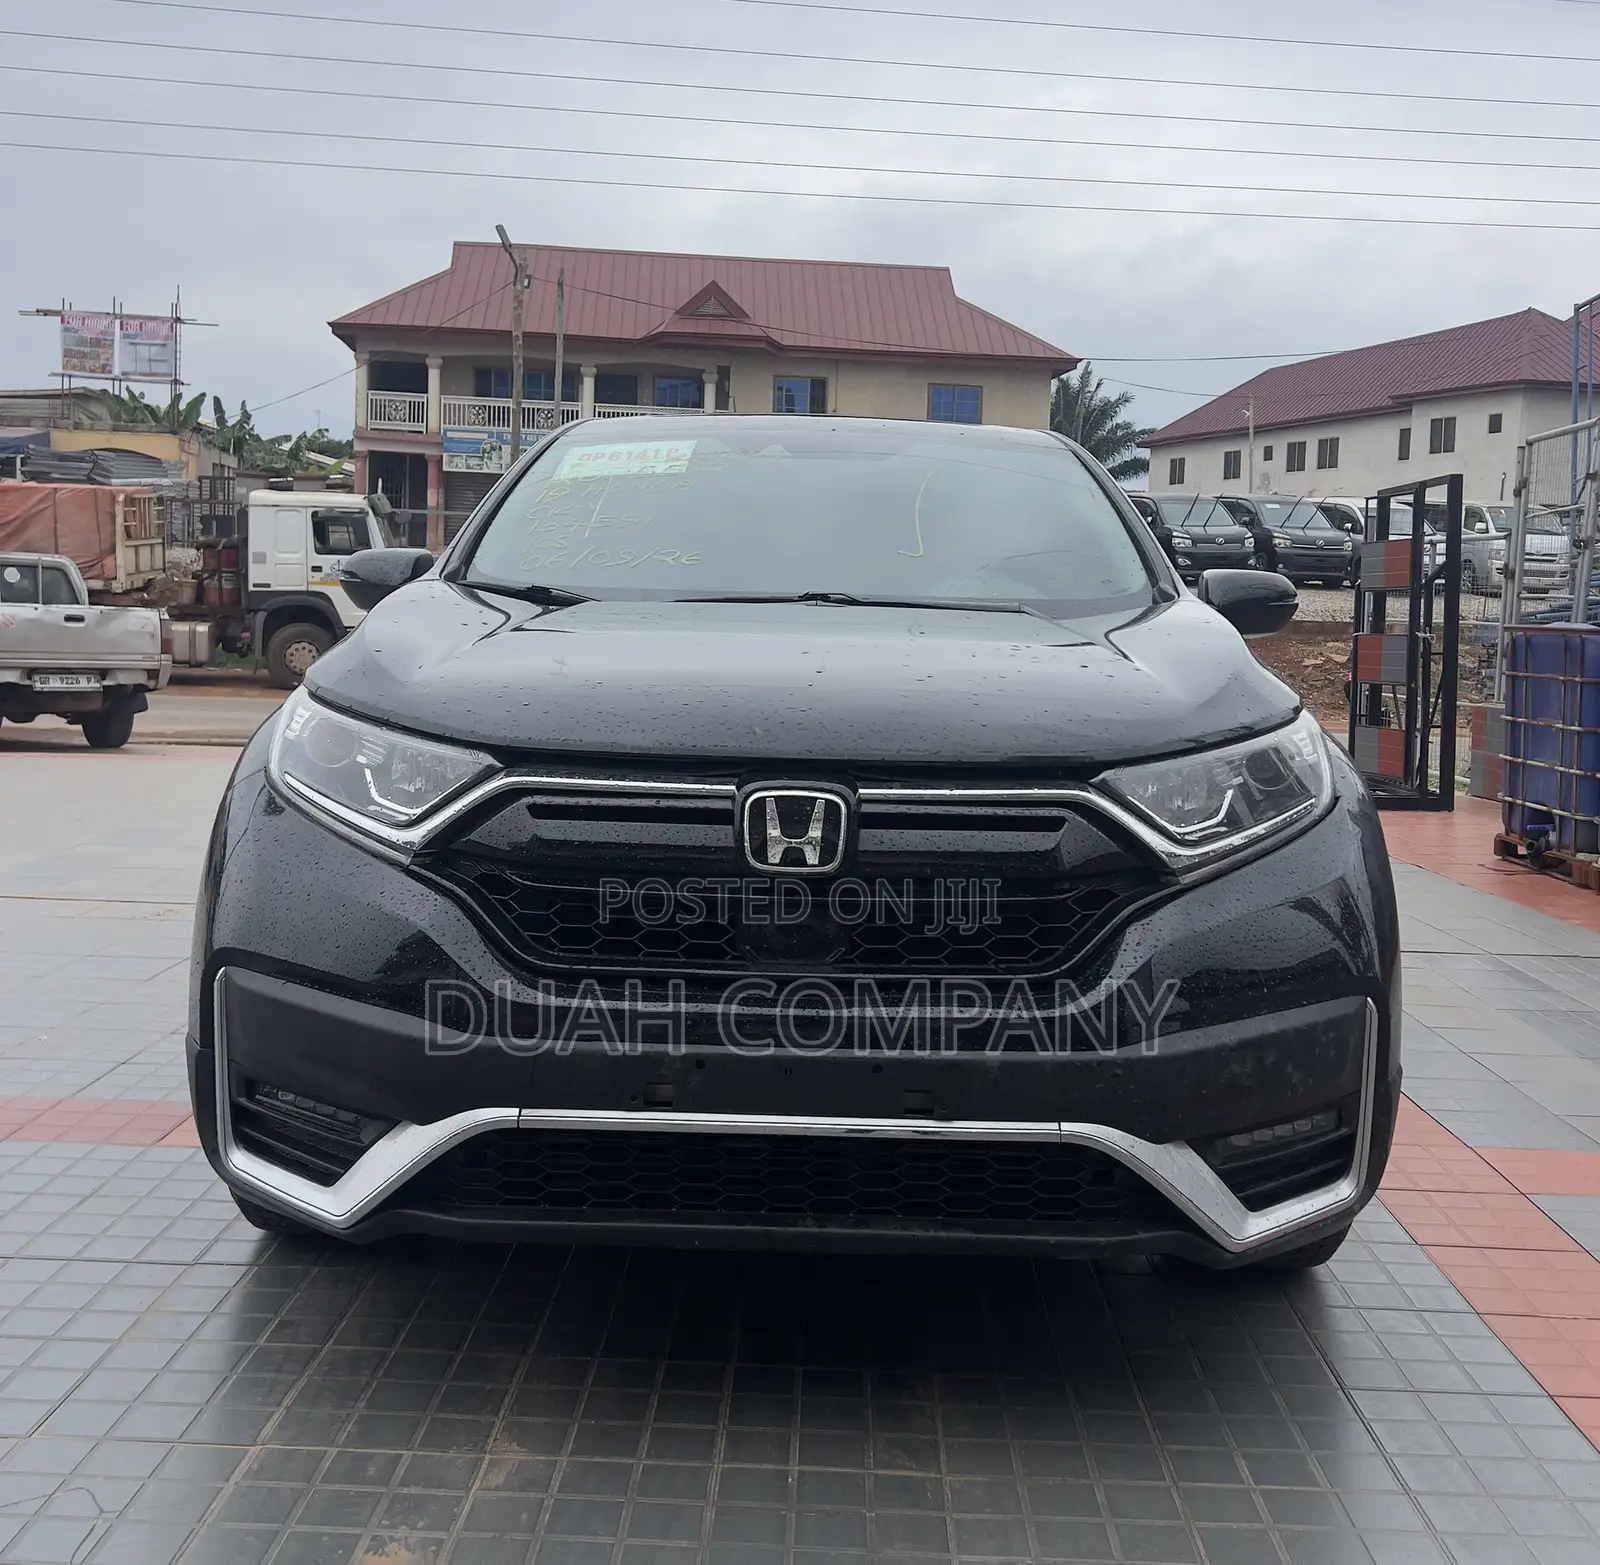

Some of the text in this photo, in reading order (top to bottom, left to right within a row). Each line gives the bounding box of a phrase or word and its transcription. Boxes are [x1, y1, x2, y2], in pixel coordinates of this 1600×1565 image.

[64, 314, 83, 327] FOR
[124, 319, 171, 333] FOR HIRING
[59, 676, 81, 685] 9226
